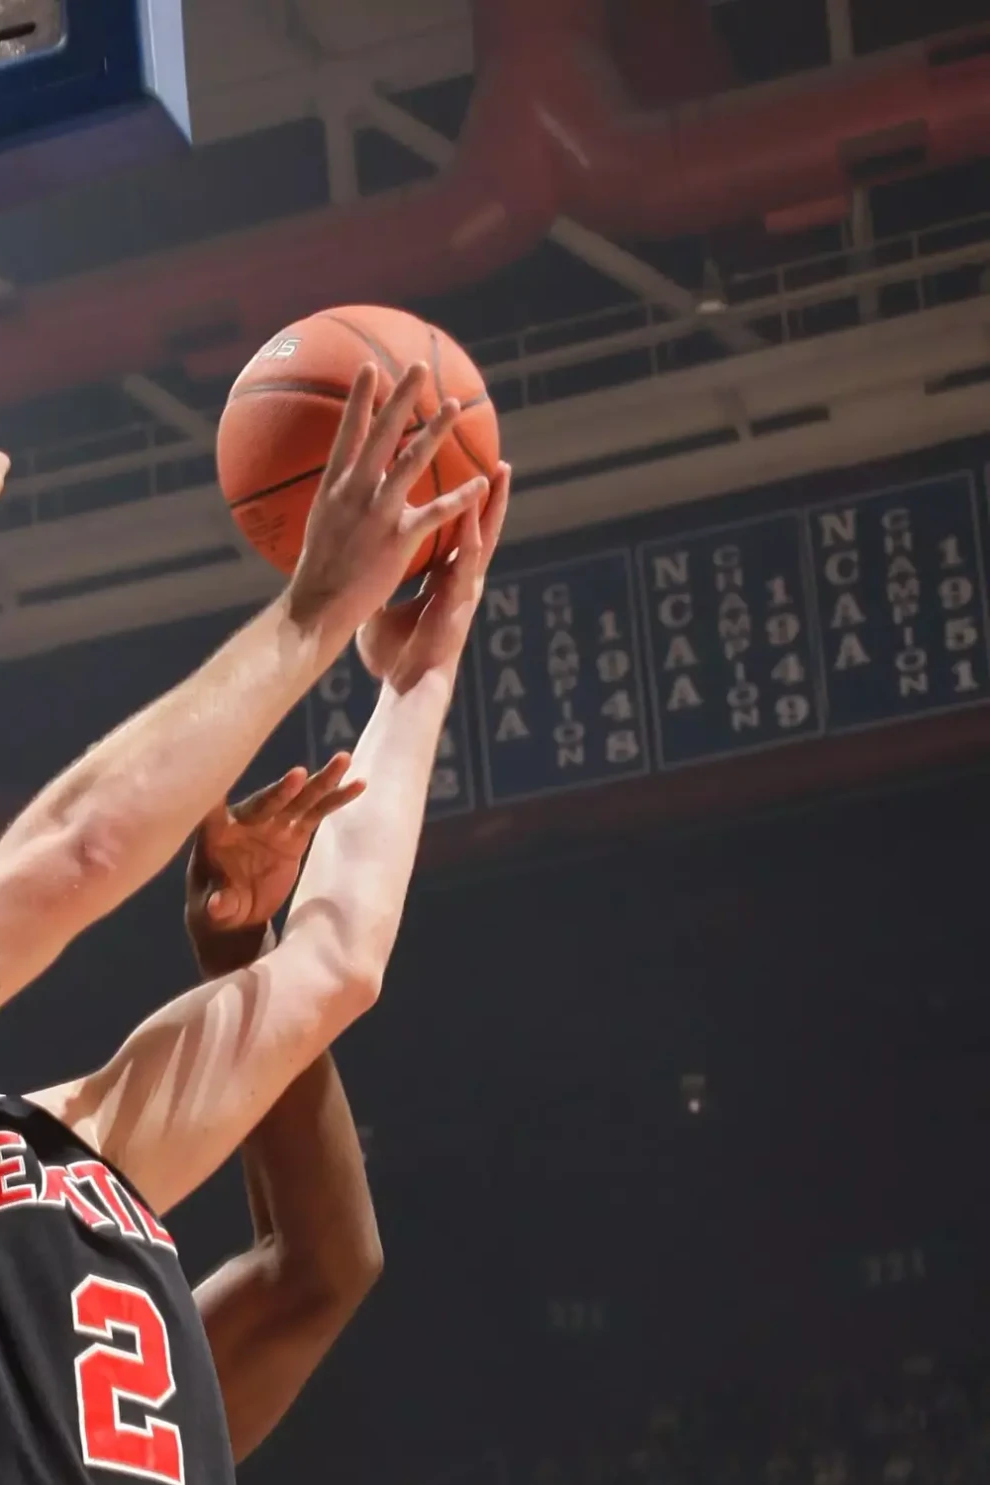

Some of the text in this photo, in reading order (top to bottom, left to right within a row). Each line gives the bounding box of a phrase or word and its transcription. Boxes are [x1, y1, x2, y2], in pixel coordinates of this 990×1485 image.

[485, 584, 530, 743] NCAA
[651, 551, 704, 713] NCAA
[765, 575, 809, 729] 1949
[817, 508, 871, 672] NCAA
[938, 532, 980, 693] 1951
